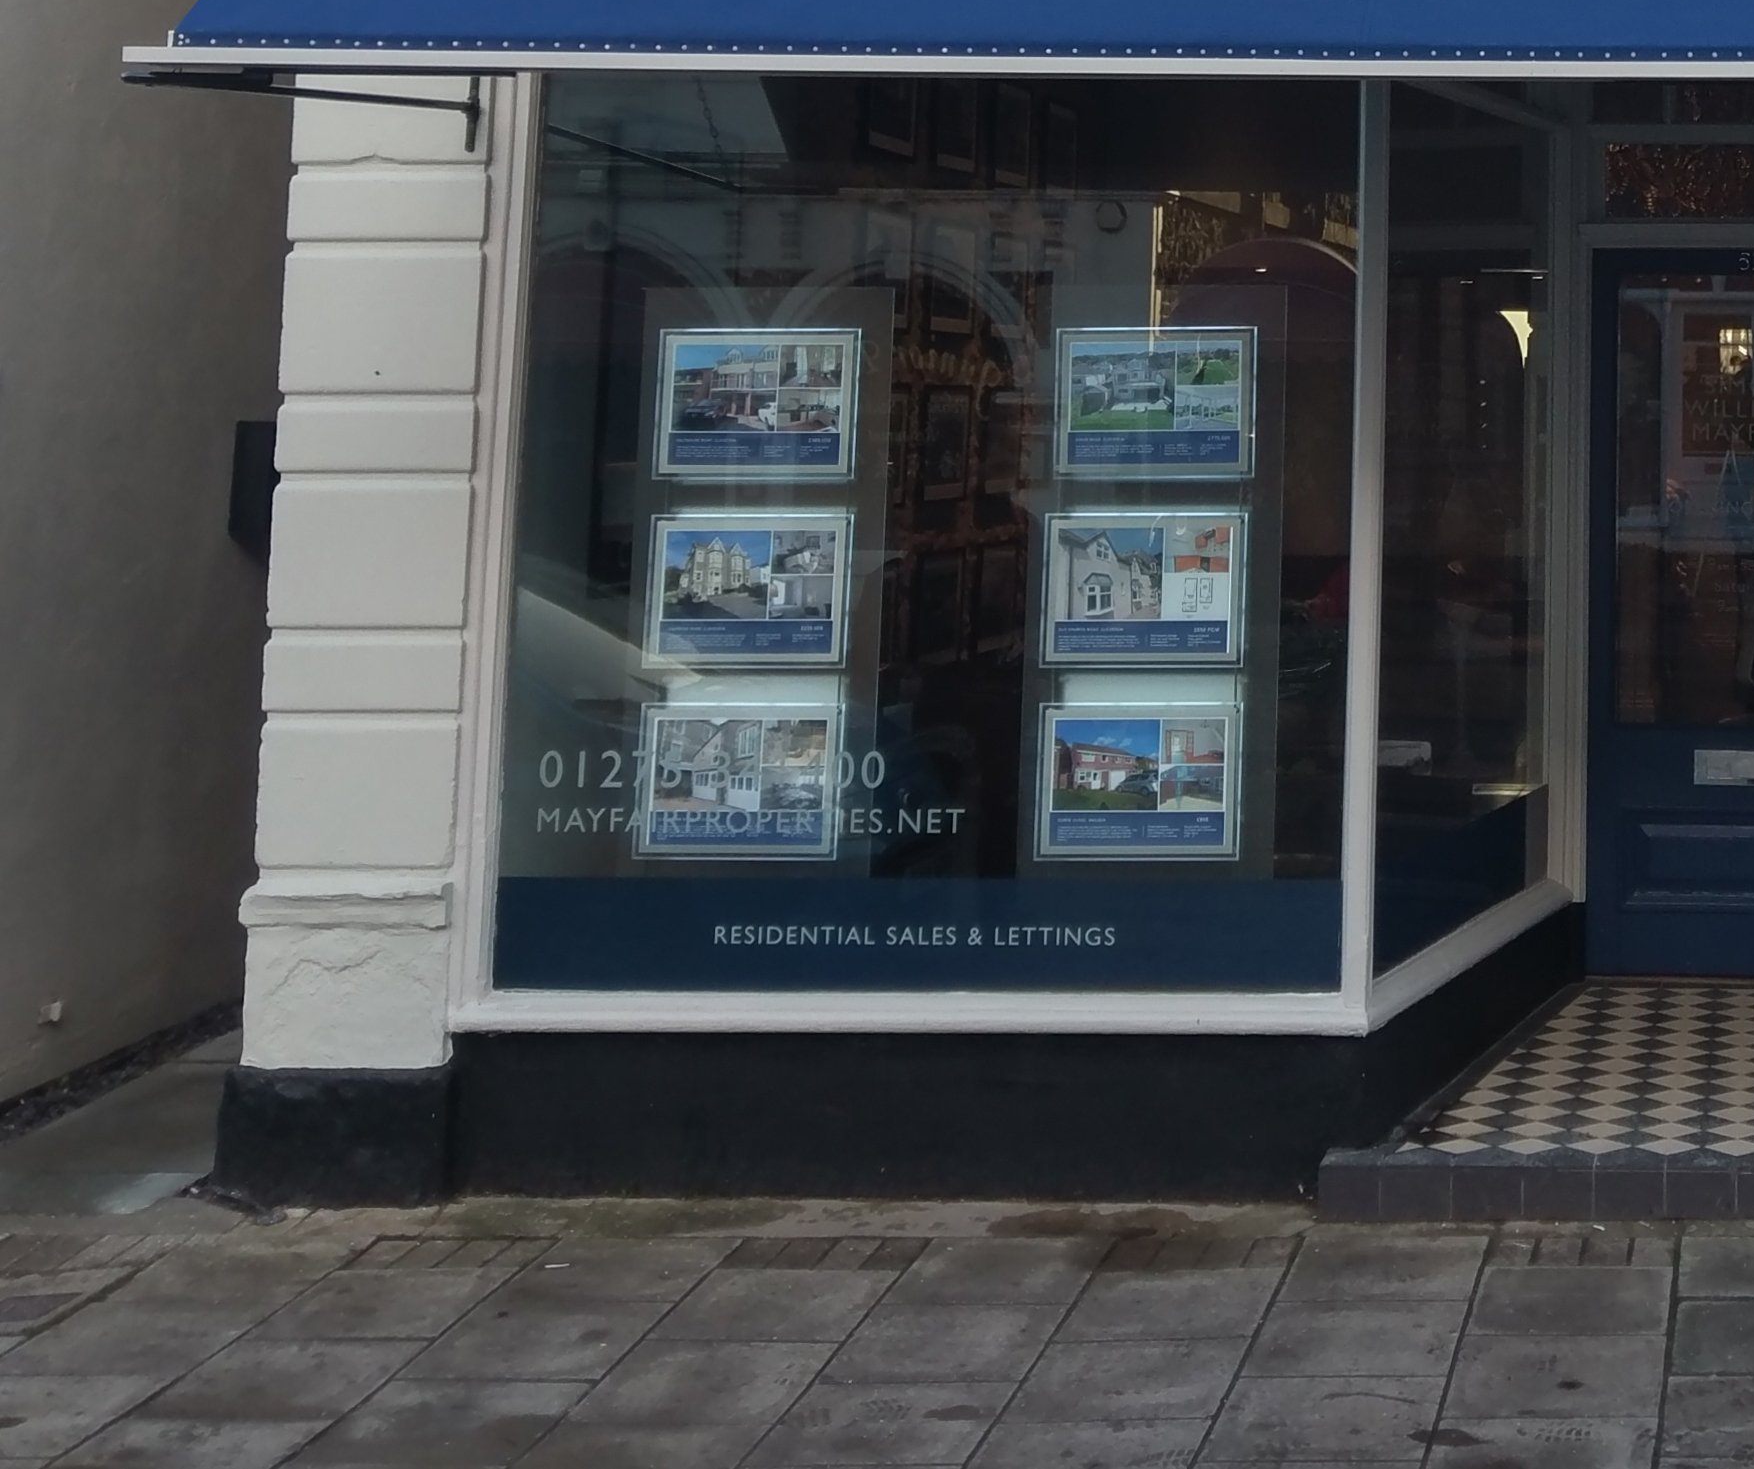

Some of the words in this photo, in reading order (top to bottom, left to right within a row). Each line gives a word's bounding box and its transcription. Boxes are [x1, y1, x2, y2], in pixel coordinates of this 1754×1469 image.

[540, 749, 682, 790] 01275
[537, 808, 967, 835] MAYFAIRPROPERIES.NET
[713, 925, 876, 946] RESIDENTIAL
[886, 925, 957, 946] SALES
[967, 926, 983, 946] &
[994, 926, 1116, 947] LETTINGS
